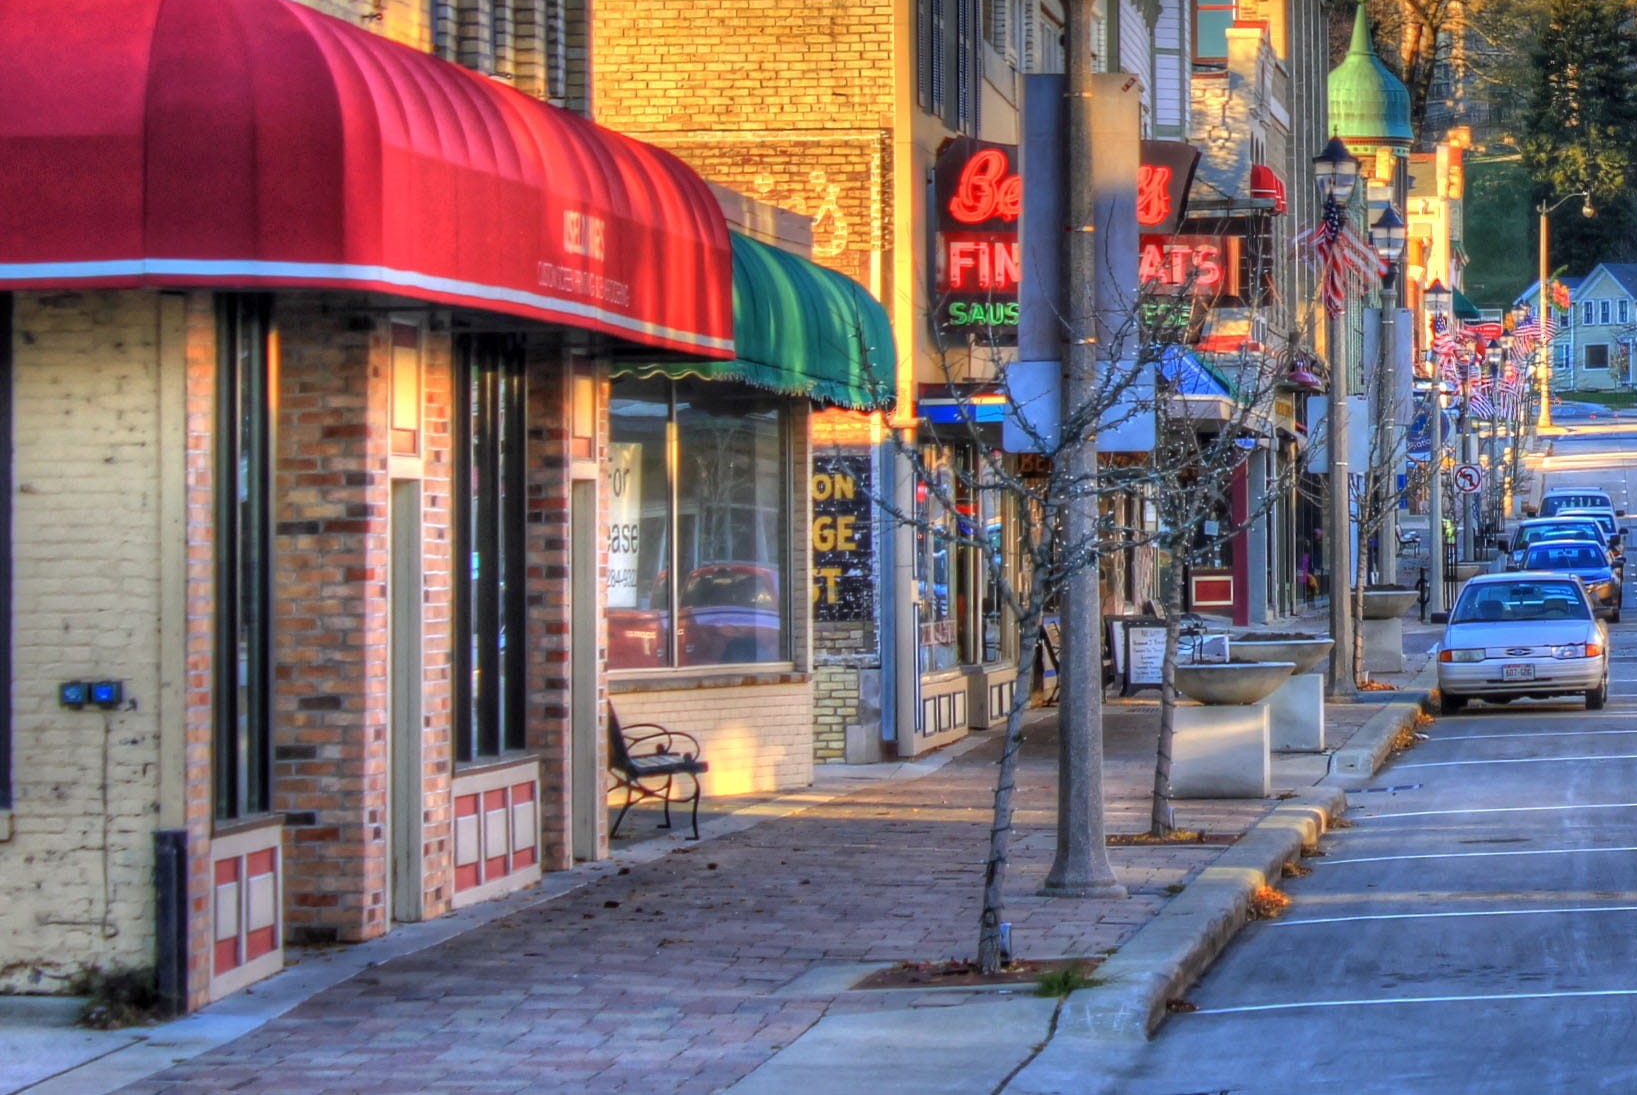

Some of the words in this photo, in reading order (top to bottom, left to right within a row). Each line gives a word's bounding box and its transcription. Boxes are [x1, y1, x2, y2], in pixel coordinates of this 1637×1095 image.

[950, 241, 1022, 288] FIN
[1139, 244, 1221, 284] ATS
[949, 302, 1020, 326] SAUS
[608, 457, 629, 497] or
[607, 523, 638, 554] ase
